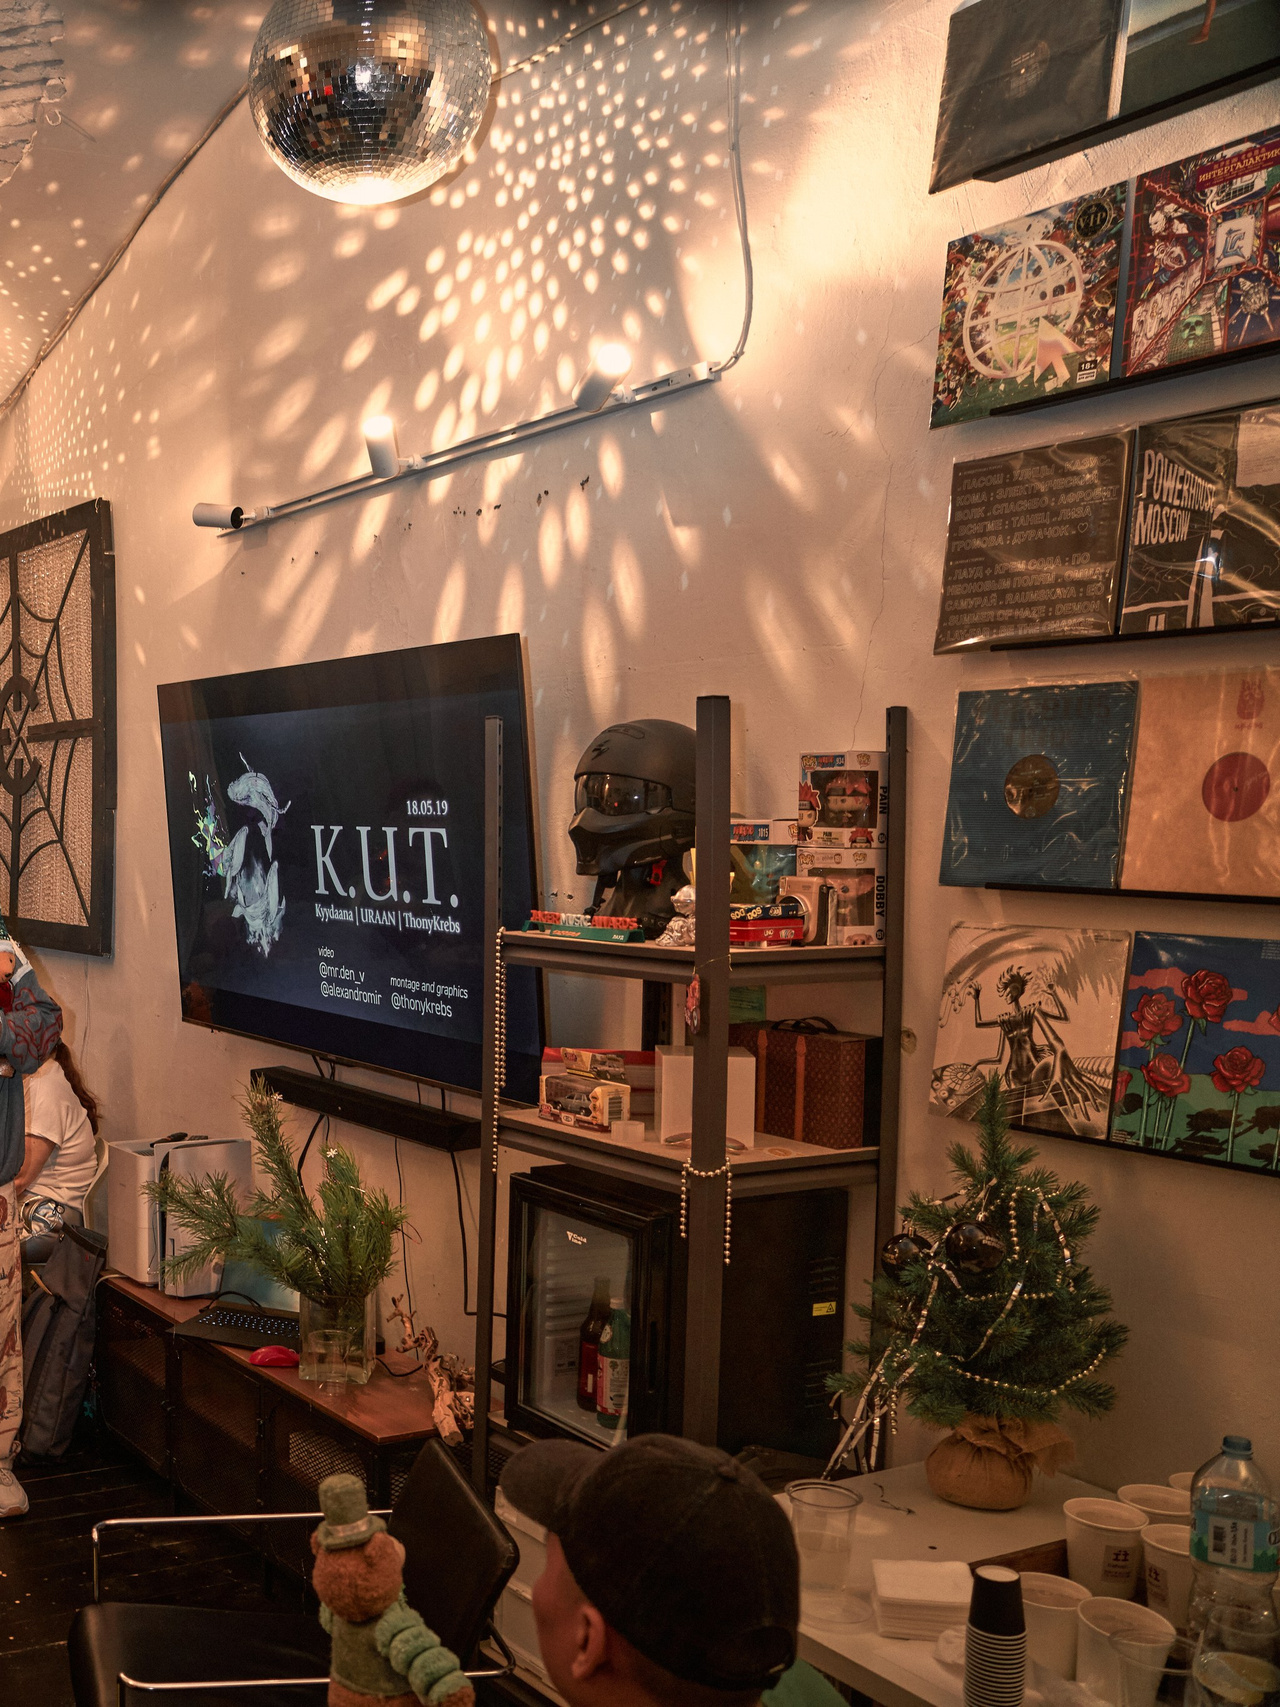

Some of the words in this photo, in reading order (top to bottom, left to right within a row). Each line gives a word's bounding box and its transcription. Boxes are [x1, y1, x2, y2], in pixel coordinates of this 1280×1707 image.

[1080, 211, 1106, 228] VIP
[1142, 449, 1216, 513] POWERHOUSE
[954, 506, 984, 522] ВОЛК
[992, 496, 1048, 515] СПАСИБО
[1059, 485, 1119, 504] АФРОБИТ
[956, 489, 987, 506] КОМА
[1011, 511, 1050, 528] ТАНЕЦ
[1057, 505, 1092, 521] ЛИЗА
[1134, 501, 1191, 545] MOSCOW
[951, 534, 1004, 553] ГРОМОВА
[1012, 524, 1069, 545] ДУРАЧОК
[1027, 554, 1062, 571] СОДА
[1072, 552, 1090, 566] ПО
[945, 591, 998, 611] САМУРАЙ
[948, 609, 995, 627] SUMMER
[997, 608, 1013, 621] OF
[1055, 600, 1100, 616] DEMON
[406, 800, 449, 815] 18.05.19
[879, 786, 888, 815] PAIN
[758, 828, 769, 837] 1015
[310, 825, 459, 908] K.U.T.
[875, 876, 885, 917] DOBBY
[315, 903, 354, 922] Kyydaana
[360, 908, 396, 926] URAAN
[403, 912, 460, 936] ThonyKrebs
[560, 913, 591, 928] MUSIC
[591, 916, 638, 930] AWARDS
[318, 946, 334, 958] video
[319, 961, 365, 985] @mr.den_v
[320, 981, 382, 1005] @alexandromir
[390, 976, 420, 993] montage
[421, 981, 435, 993] and
[436, 983, 468, 999] graphics
[391, 992, 452, 1018] @thonykrebs
